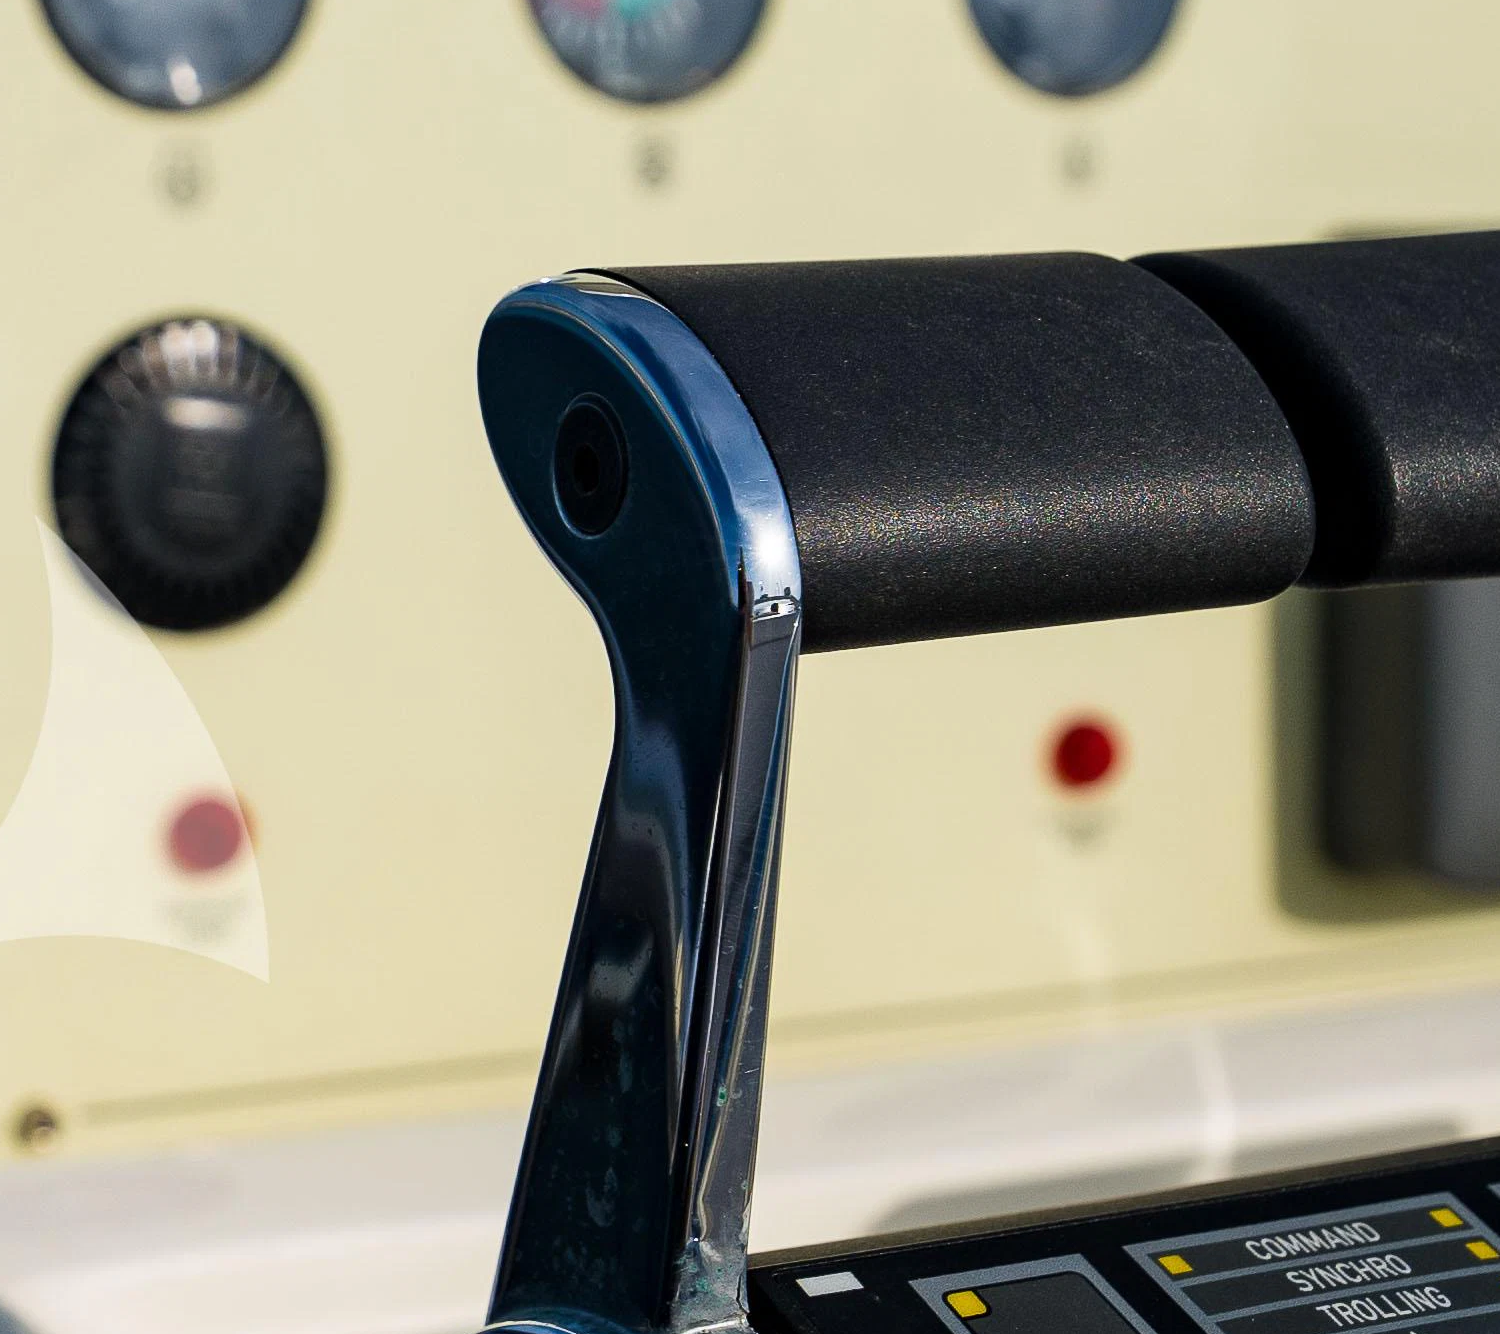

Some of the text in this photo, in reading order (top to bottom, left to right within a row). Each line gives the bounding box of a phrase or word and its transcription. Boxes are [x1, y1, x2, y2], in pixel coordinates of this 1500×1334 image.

[1245, 1221, 1381, 1260] COMMAND
[1286, 1253, 1412, 1292] SYNCHRO
[1315, 1286, 1452, 1327] TROLLING
